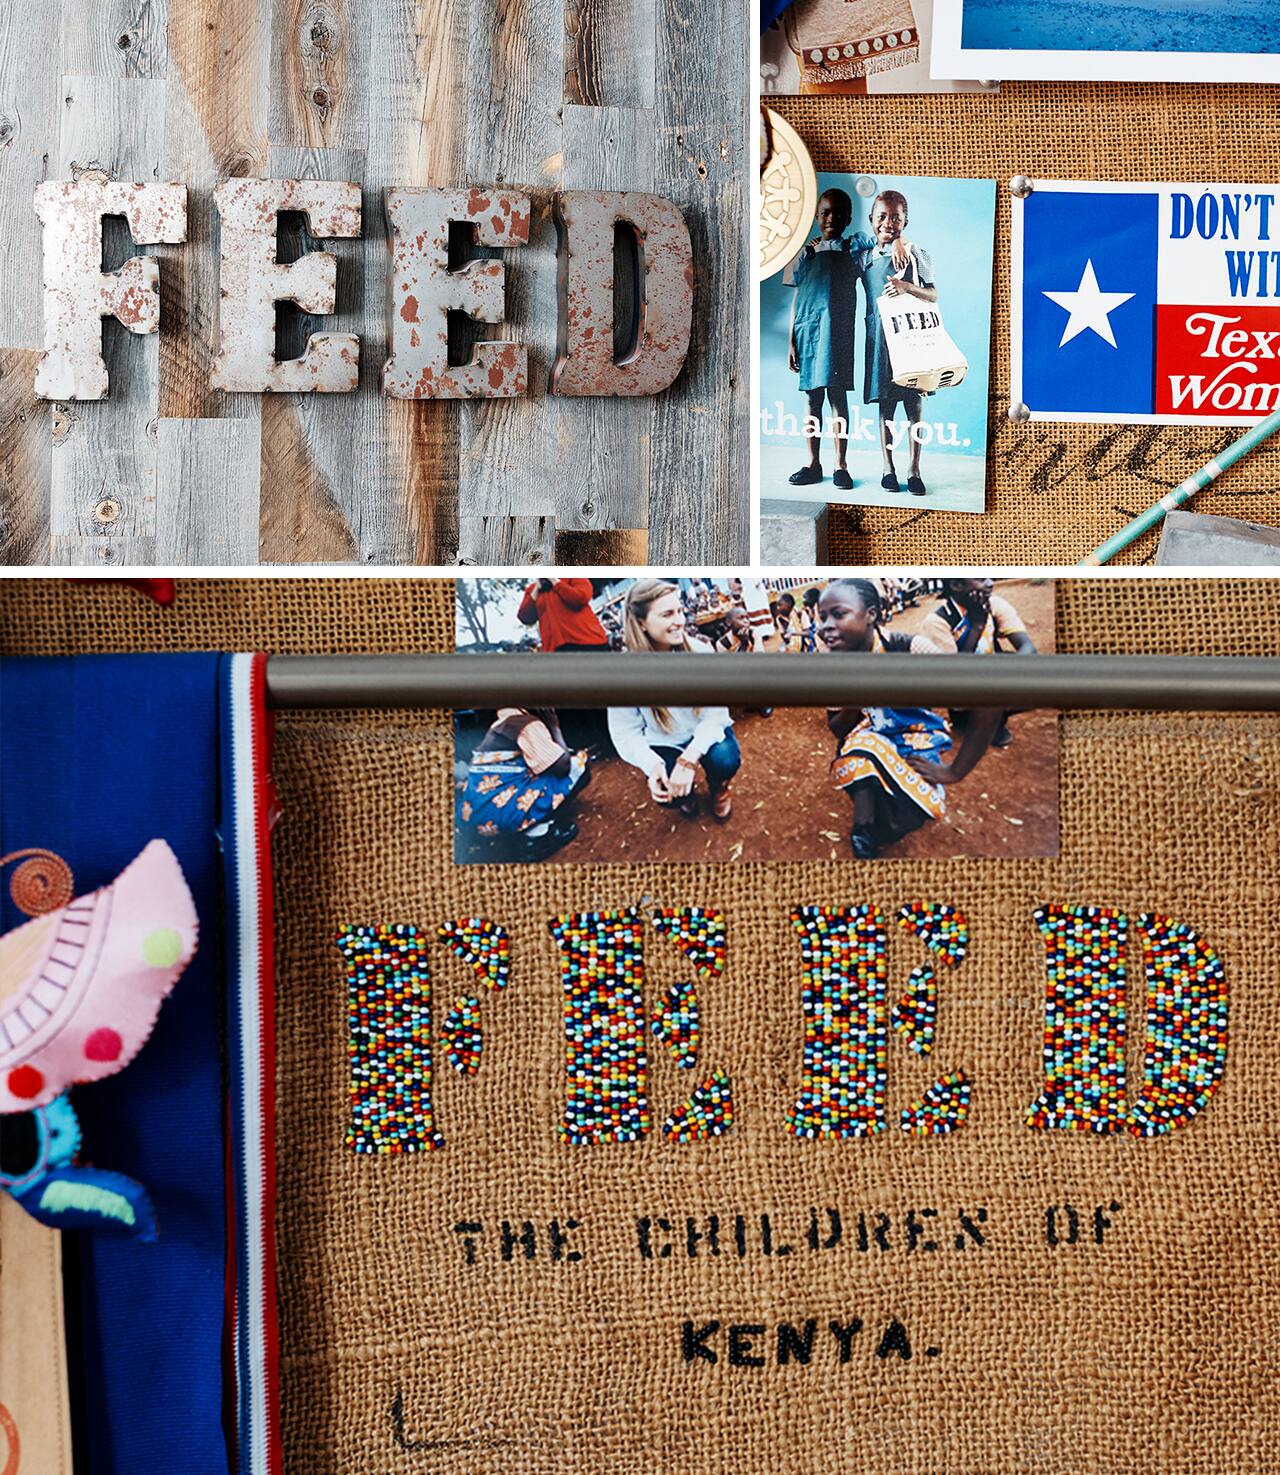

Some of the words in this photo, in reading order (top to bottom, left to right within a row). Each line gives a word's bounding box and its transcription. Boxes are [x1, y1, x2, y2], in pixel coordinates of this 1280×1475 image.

[1170, 193, 1275, 241] DON'T
[34, 177, 694, 400] FEED
[891, 311, 940, 334] FEED
[760, 401, 876, 441] thank
[885, 420, 972, 451] you.
[336, 901, 1230, 1154] FEED
[454, 1216, 583, 1264] THE
[636, 1207, 987, 1258] CHILDREN
[1045, 1200, 1121, 1245] OF
[682, 1317, 938, 1366] KENYA.
